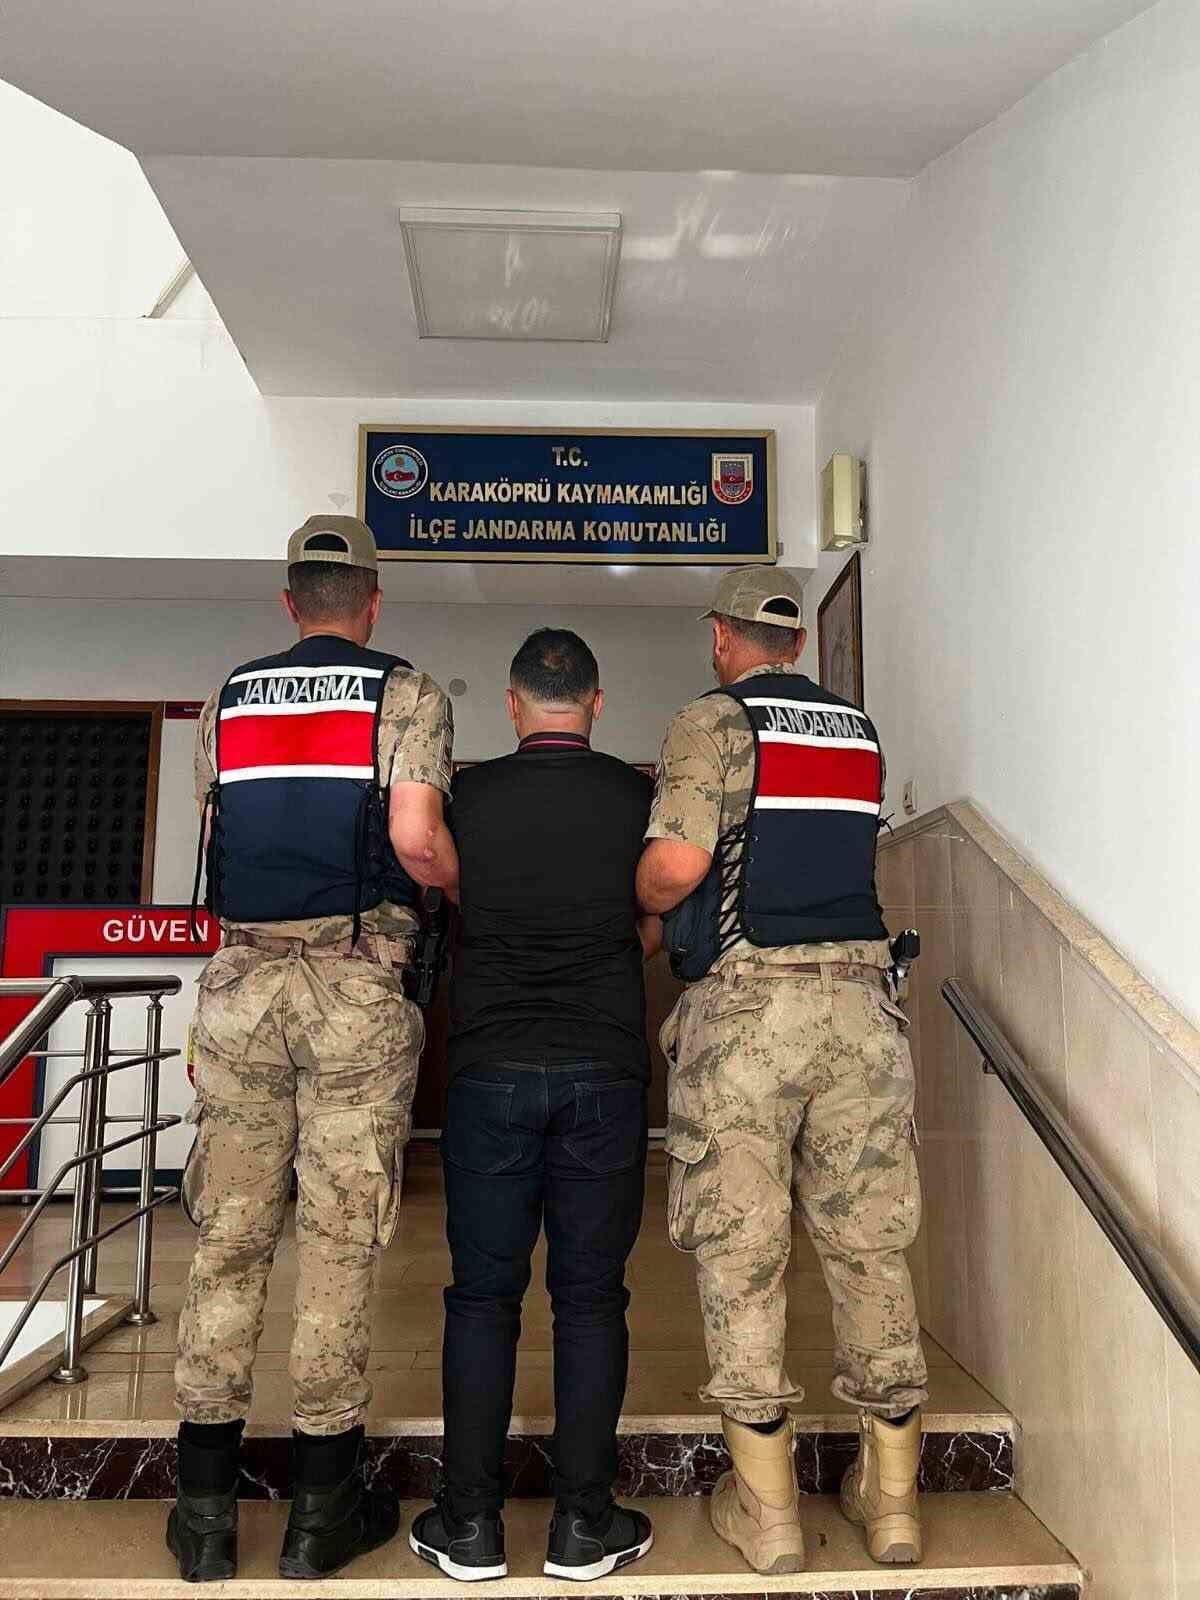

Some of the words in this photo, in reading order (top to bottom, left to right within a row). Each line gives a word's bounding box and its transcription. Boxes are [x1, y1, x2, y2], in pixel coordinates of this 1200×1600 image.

[552, 446, 589, 467] T.C.
[429, 477, 551, 503] KARAKÖPRÜ
[557, 480, 708, 505] KAYMAKAMLIĞI
[409, 513, 456, 544] İLÇE
[462, 519, 577, 541] JANDARMA
[583, 518, 727, 543] KOMUTANLIĞI
[236, 674, 366, 706] JANDARMA
[765, 706, 868, 739] JANDARMA
[103, 914, 209, 942] GÜVEN
